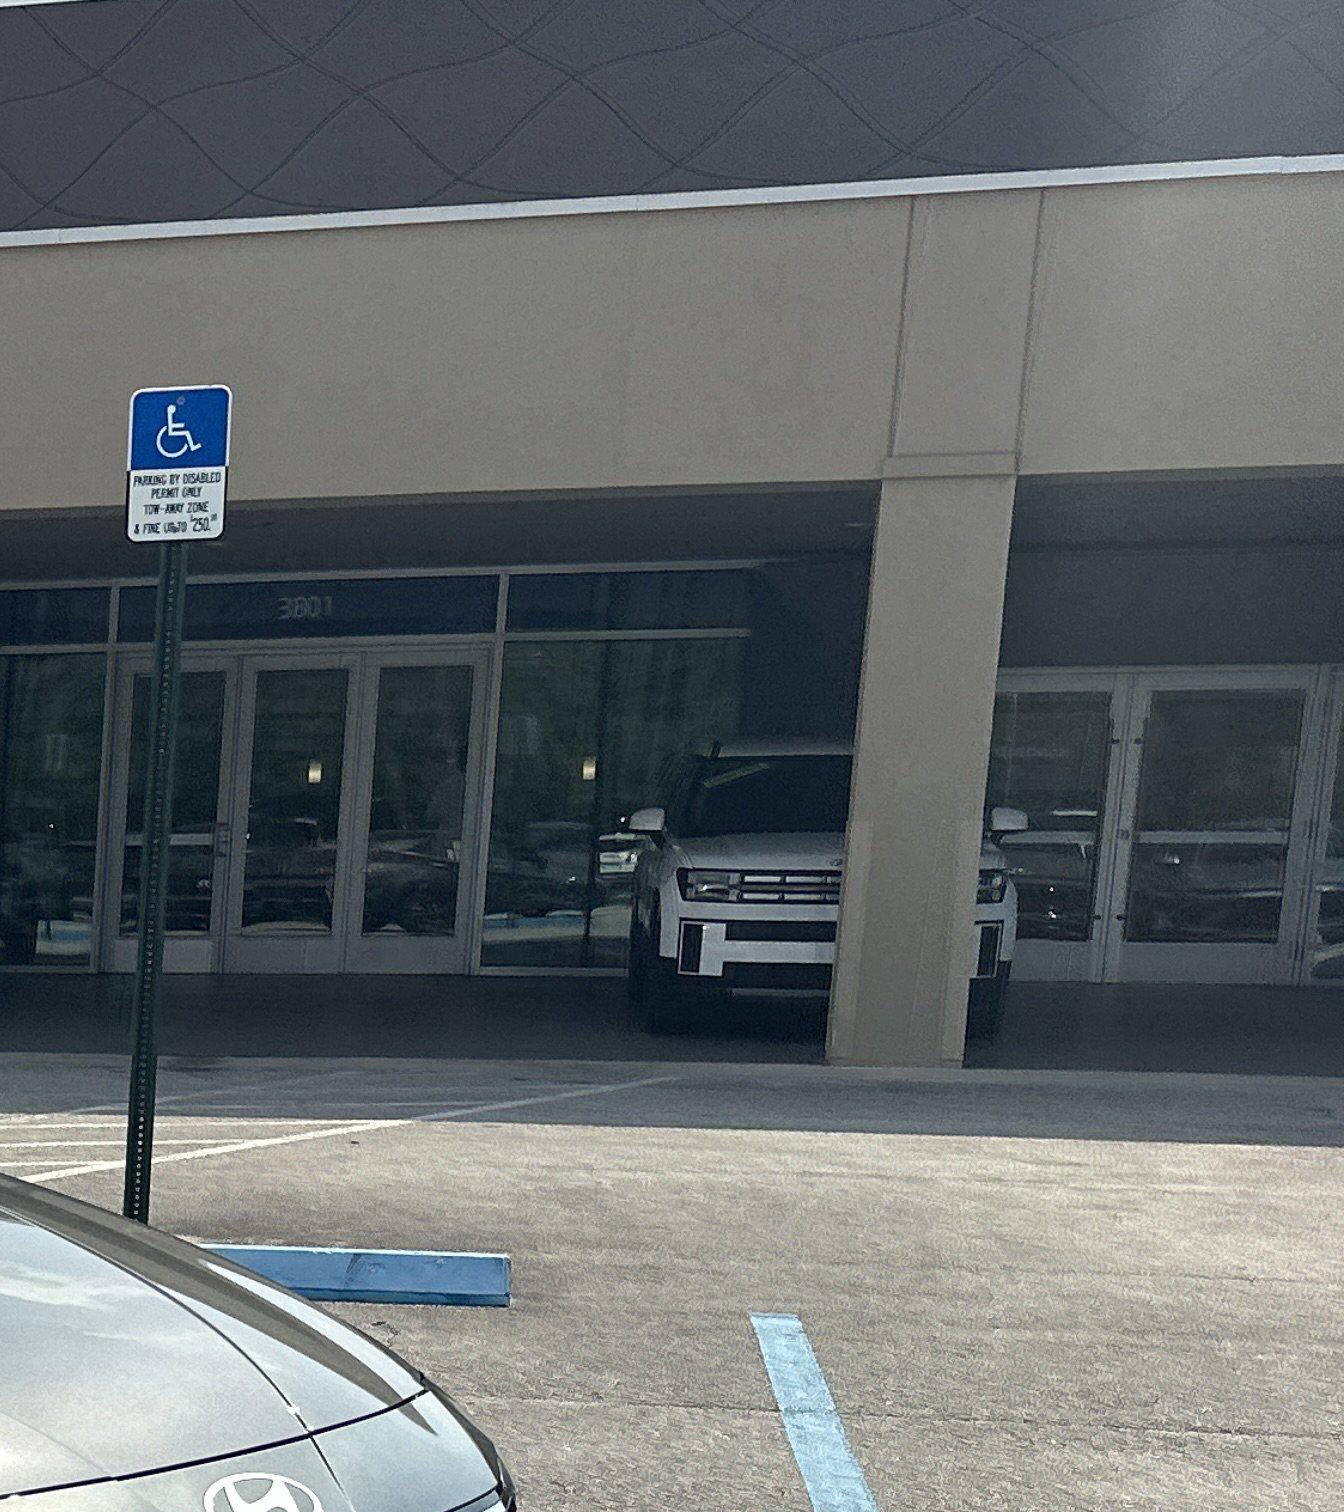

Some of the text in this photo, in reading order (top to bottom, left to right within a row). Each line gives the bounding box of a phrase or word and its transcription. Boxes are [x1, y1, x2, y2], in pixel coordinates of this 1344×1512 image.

[133, 472, 221, 487] PARKING BY DISABLED
[151, 486, 203, 499] PERMIT ONLY
[187, 501, 209, 513] ZONE
[142, 522, 161, 534] FINE
[273, 596, 333, 620] 3801
